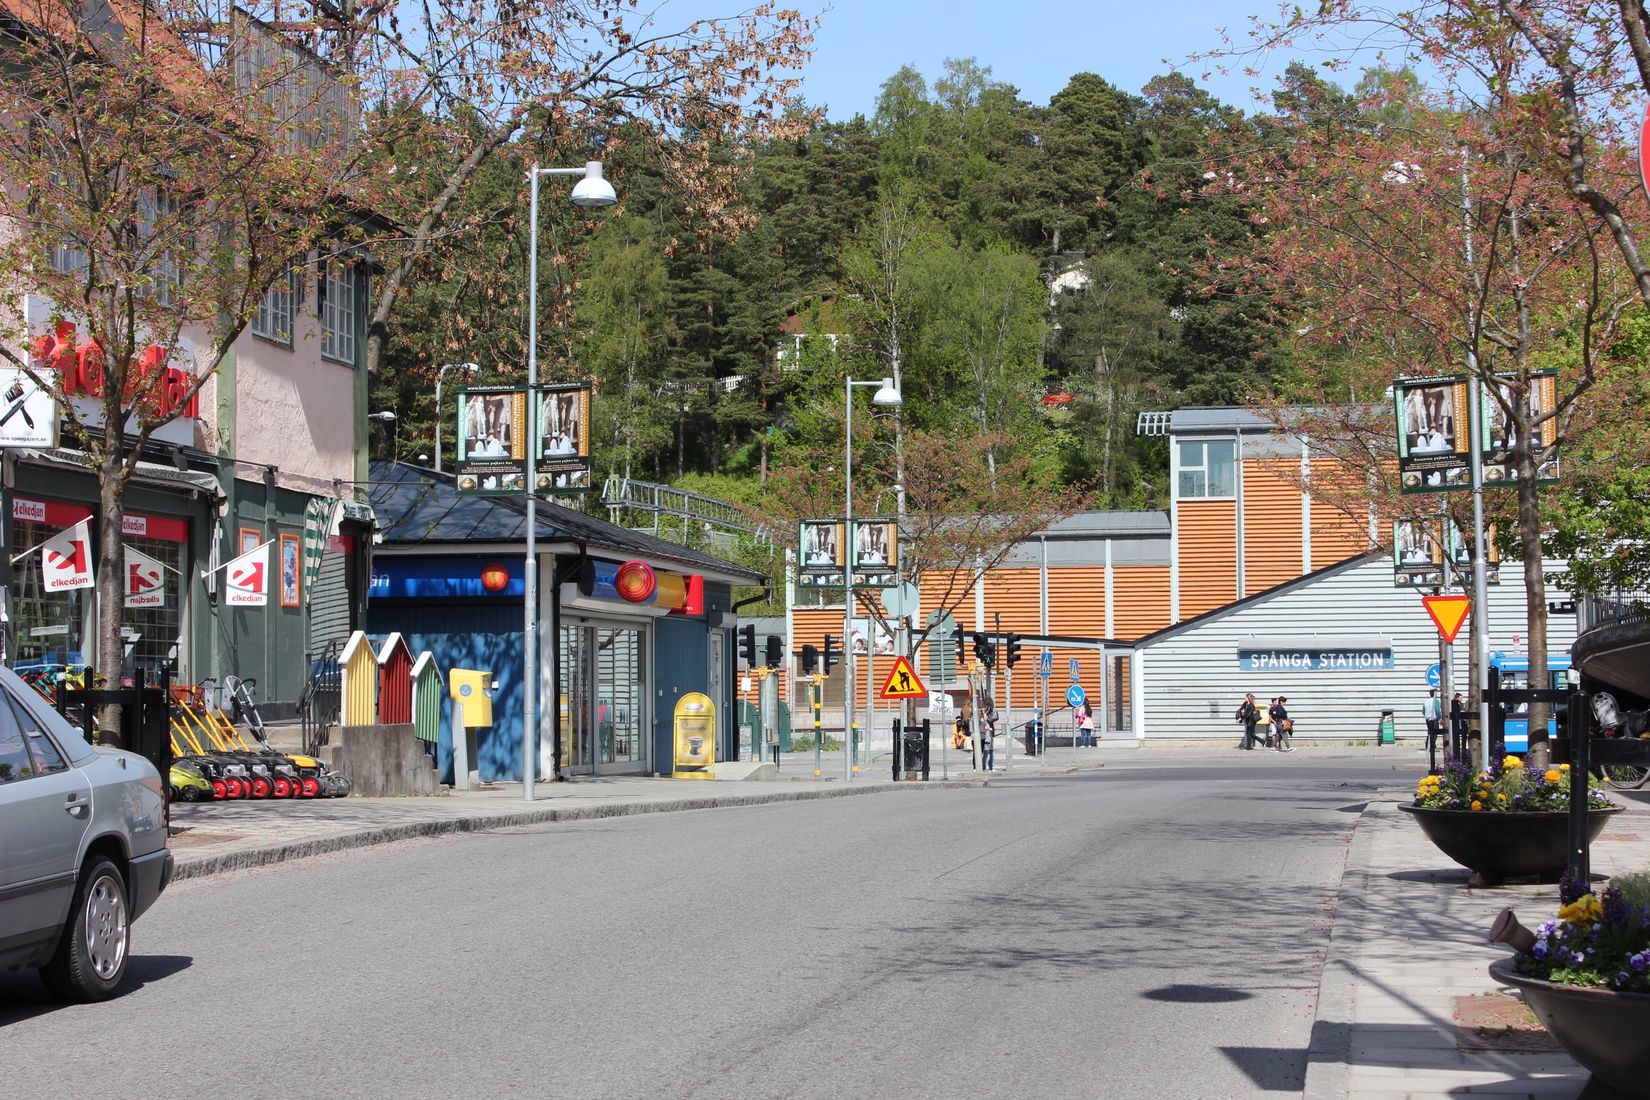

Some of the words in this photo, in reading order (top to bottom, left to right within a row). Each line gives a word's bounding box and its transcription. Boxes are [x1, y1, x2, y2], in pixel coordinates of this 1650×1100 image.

[19, 502, 44, 518] elkedjan
[51, 577, 88, 587] elkedjan
[231, 594, 263, 603] elkedjan
[1251, 651, 1312, 668] SPÅNGA
[1319, 652, 1383, 667] STATION
